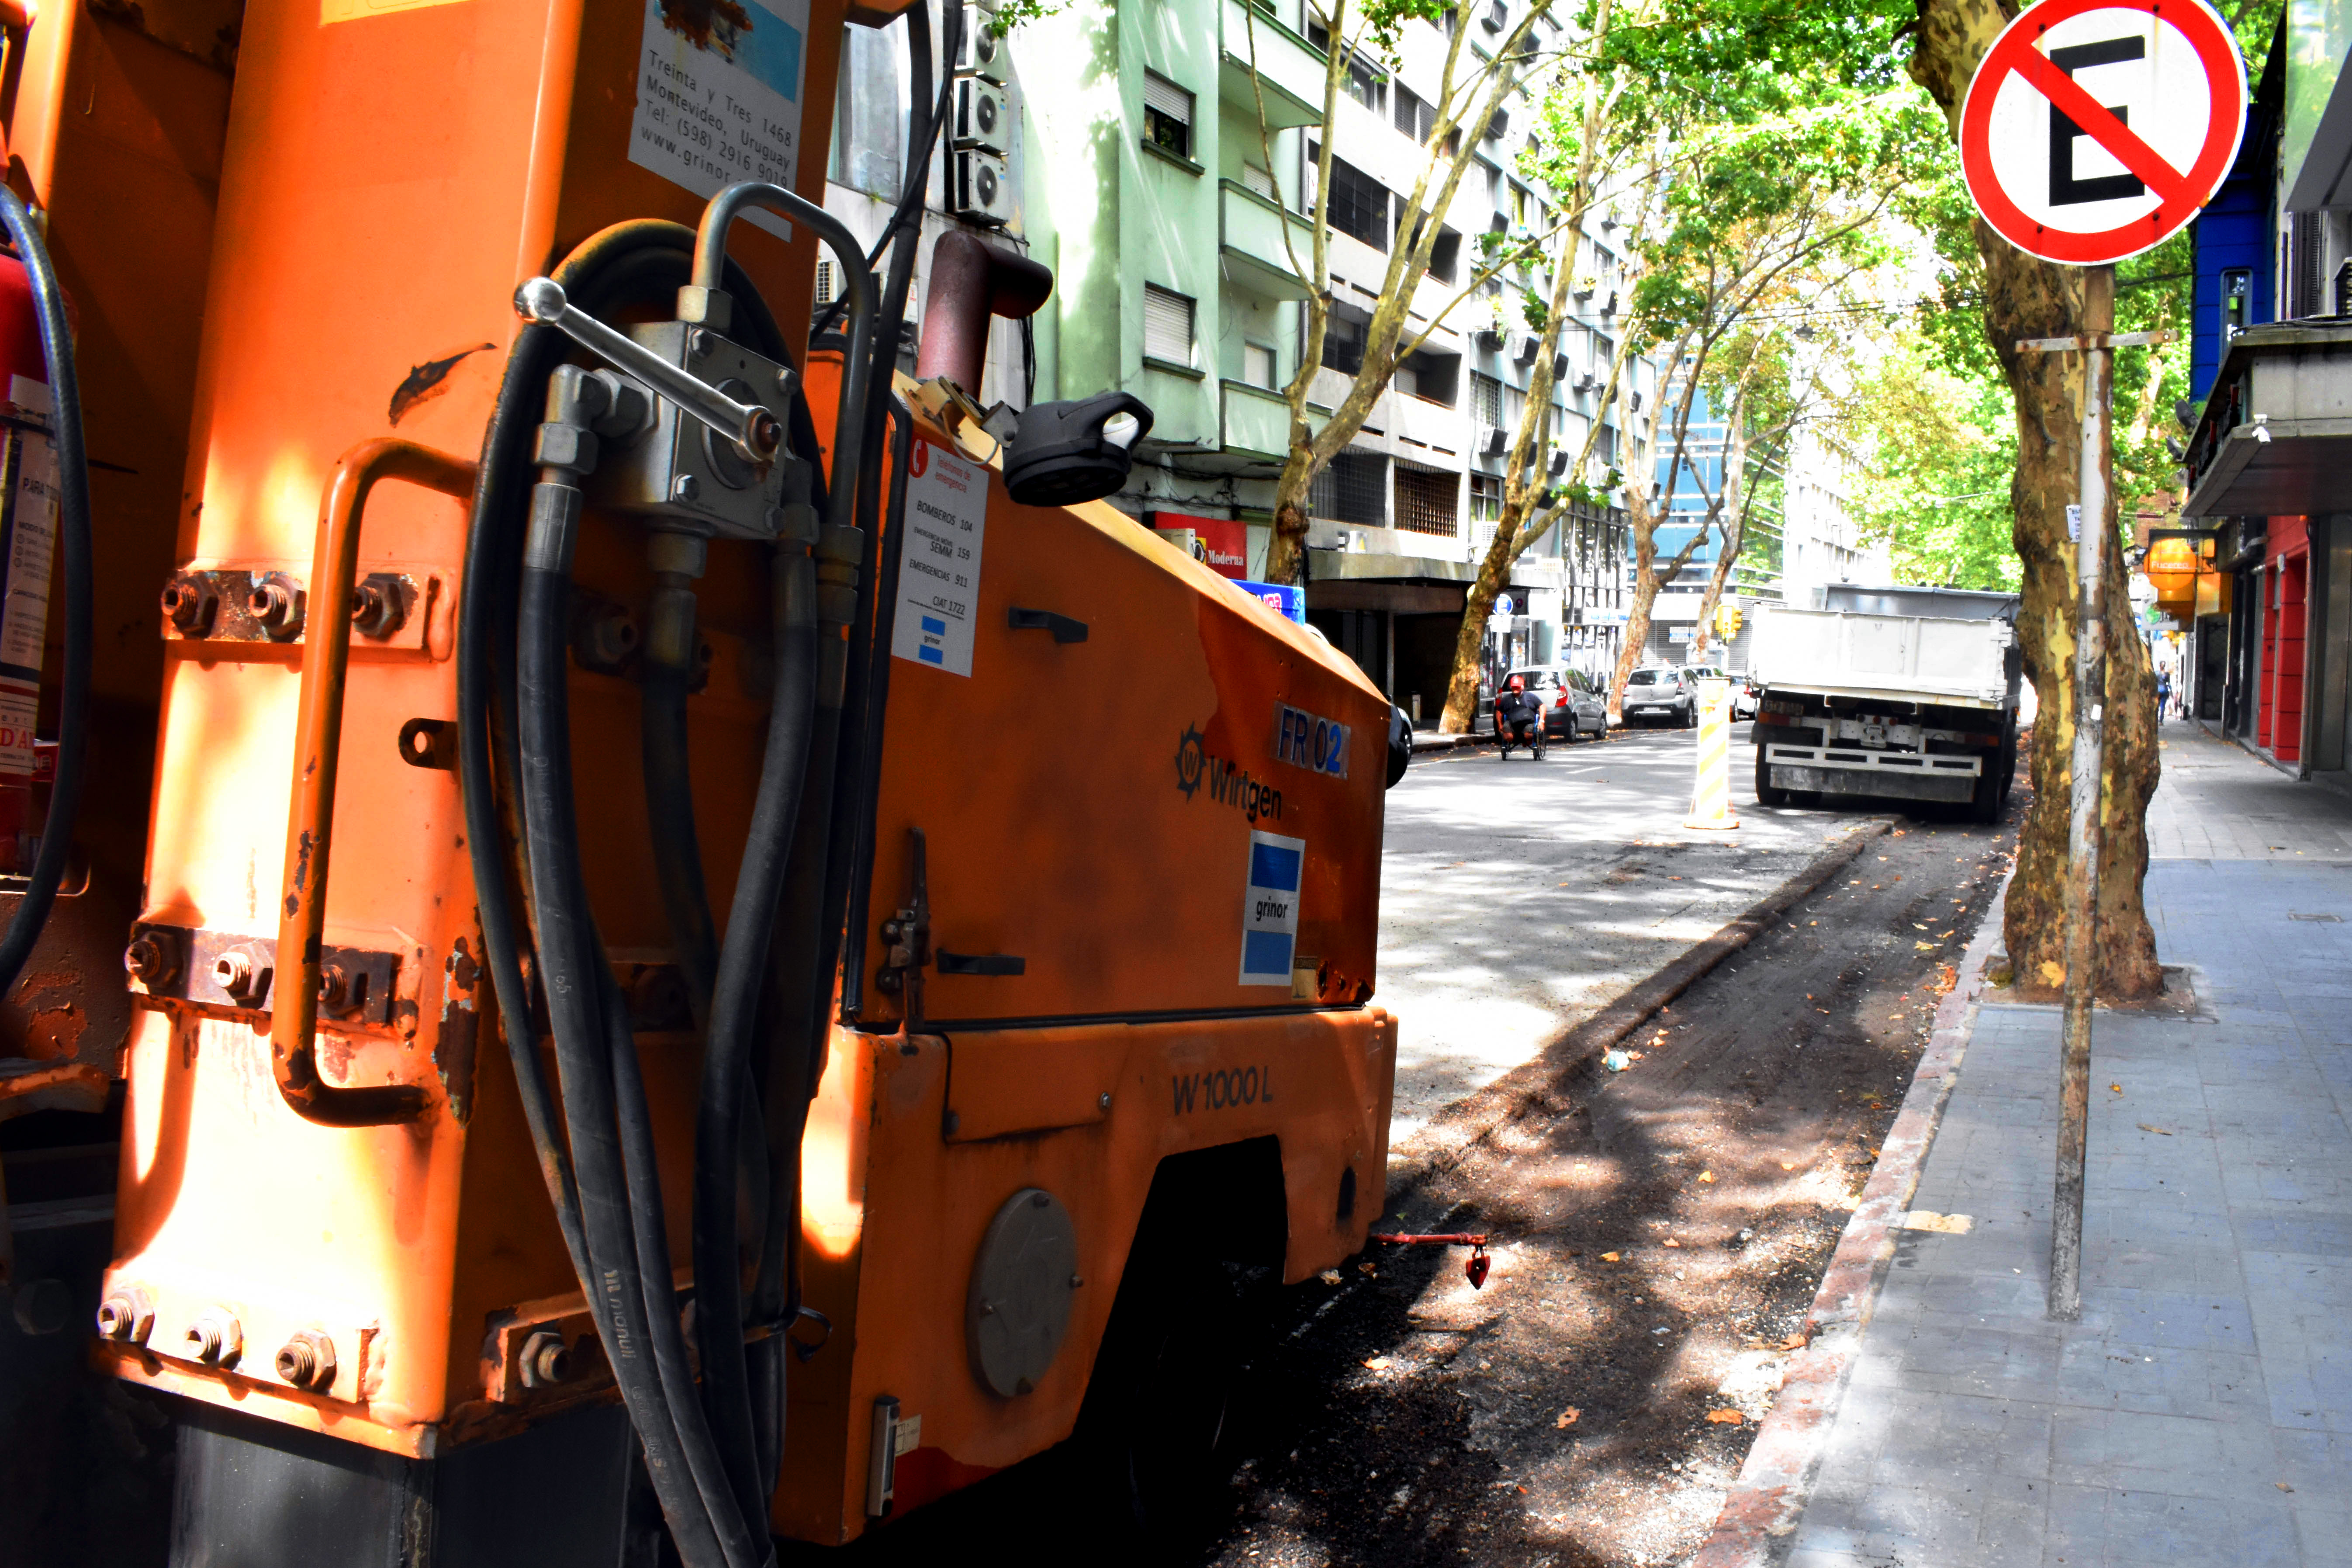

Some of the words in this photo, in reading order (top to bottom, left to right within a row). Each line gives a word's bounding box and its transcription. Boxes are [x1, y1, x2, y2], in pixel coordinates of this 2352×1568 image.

[650, 49, 696, 91] Treinta
[708, 89, 715, 104] y
[726, 95, 751, 123] Tres
[764, 118, 791, 147] 1468
[2049, 35, 2145, 206] E
[645, 98, 670, 126] Tel:
[678, 118, 712, 150] (598)
[719, 141, 751, 170] 2916
[647, 74, 726, 136] Montevideo,
[741, 129, 790, 171] Uruguay
[641, 126, 742, 183] www.grinor
[917, 500, 956, 525] BOMBEROS
[960, 519, 972, 533] 104
[930, 541, 953, 558] SEMM
[957, 547, 970, 560] 159
[1208, 550, 1244, 566] Moderna
[910, 559, 950, 582] EMERGENCIAS
[955, 574, 968, 588] 911
[933, 596, 948, 609] CIAT
[948, 601, 965, 615] 1722
[924, 635, 941, 645] grinor
[1279, 708, 1308, 764] FR
[1314, 720, 1342, 773] 02
[1210, 755, 1282, 824] Wirtgen
[1256, 896, 1288, 921] grinor
